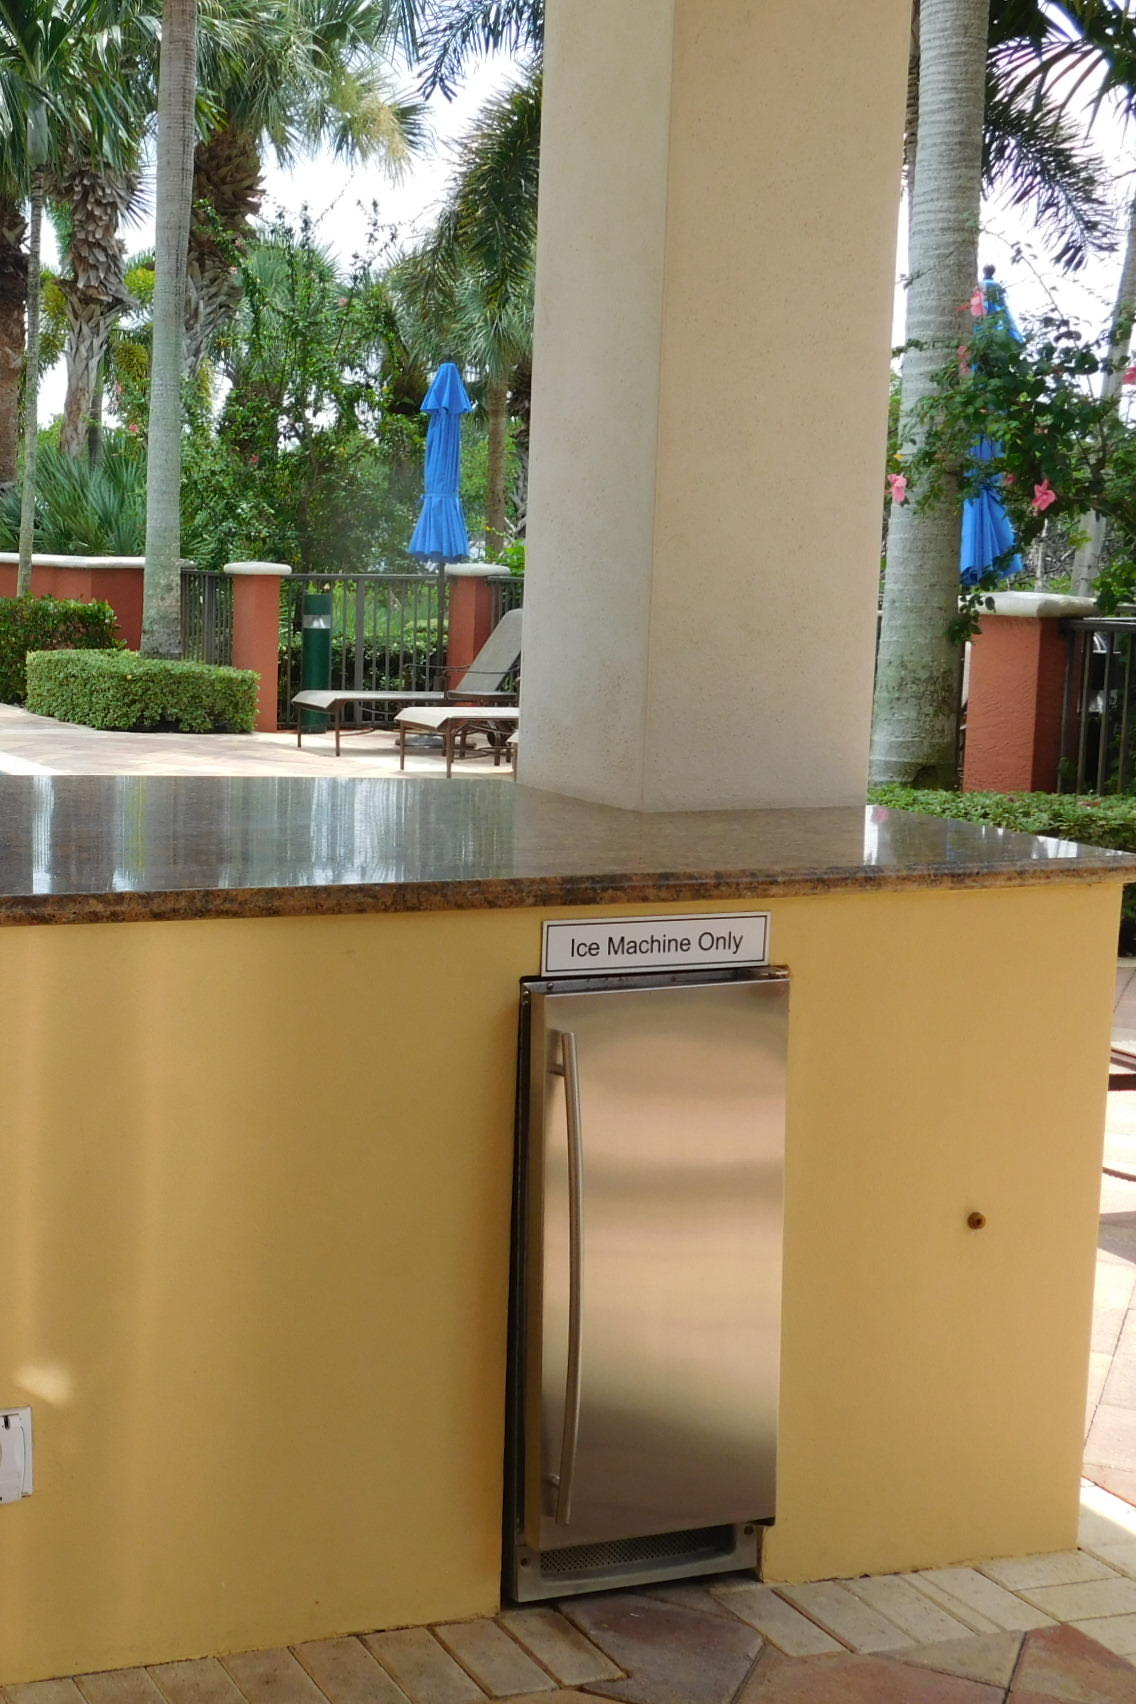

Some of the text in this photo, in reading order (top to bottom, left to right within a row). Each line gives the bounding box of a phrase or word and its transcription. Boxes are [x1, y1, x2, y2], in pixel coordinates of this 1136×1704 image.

[570, 930, 743, 957] Ice Machine Only
